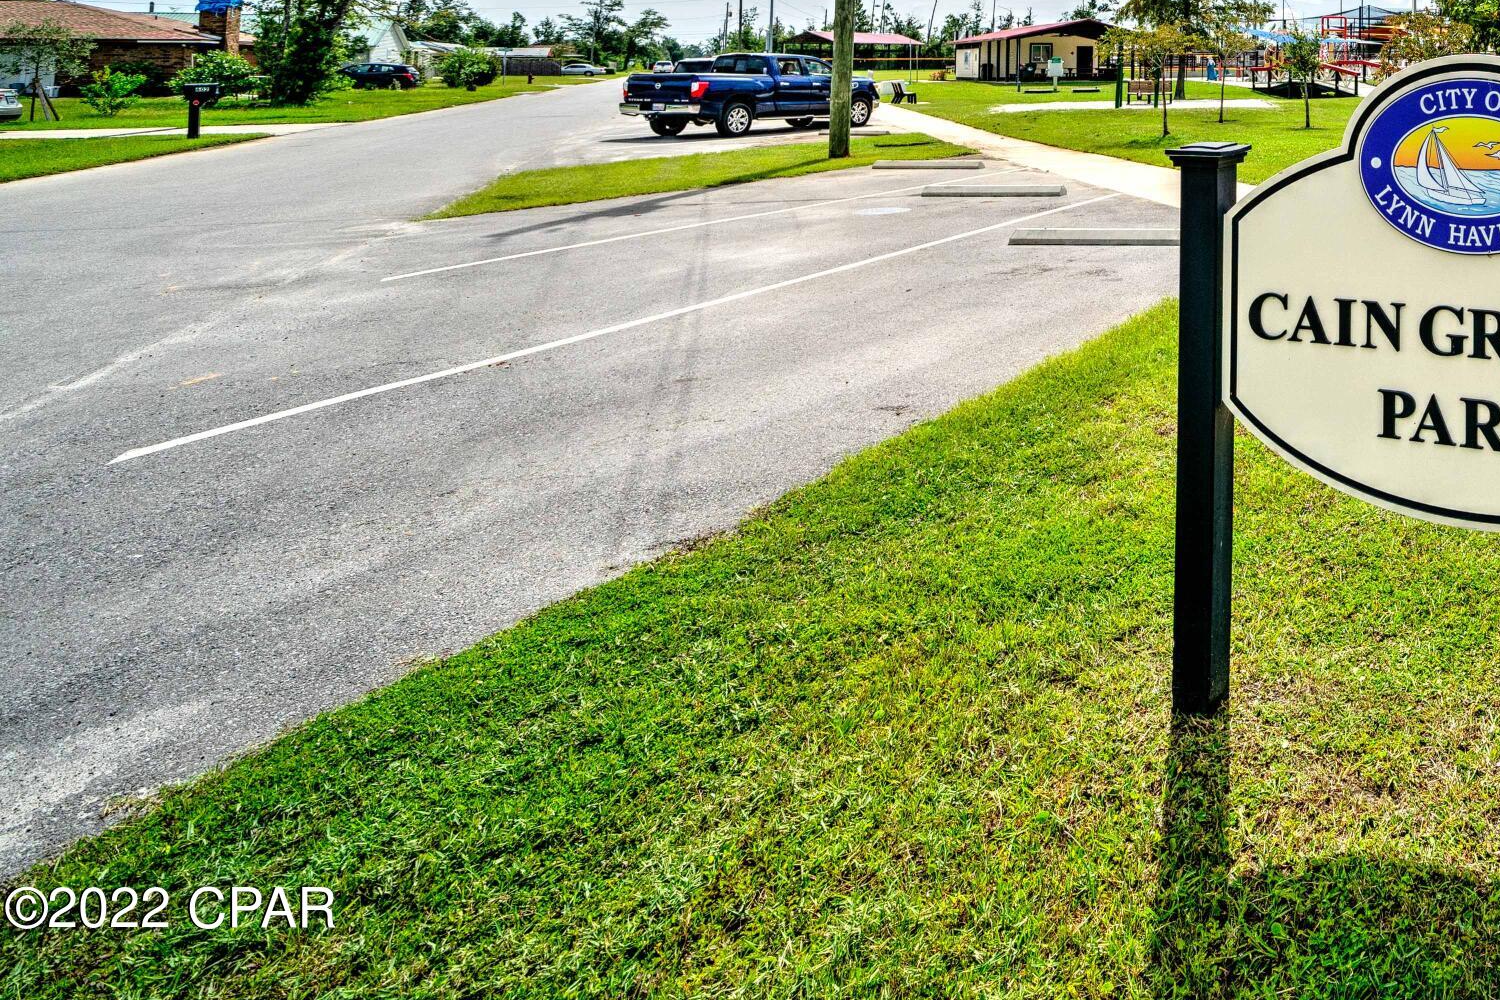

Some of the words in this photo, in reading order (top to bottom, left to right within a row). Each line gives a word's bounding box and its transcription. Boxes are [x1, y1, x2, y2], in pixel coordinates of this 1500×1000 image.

[1420, 88, 1477, 115] CITY
[1374, 184, 1437, 239] LYNN
[1248, 292, 1406, 353] CAIN
